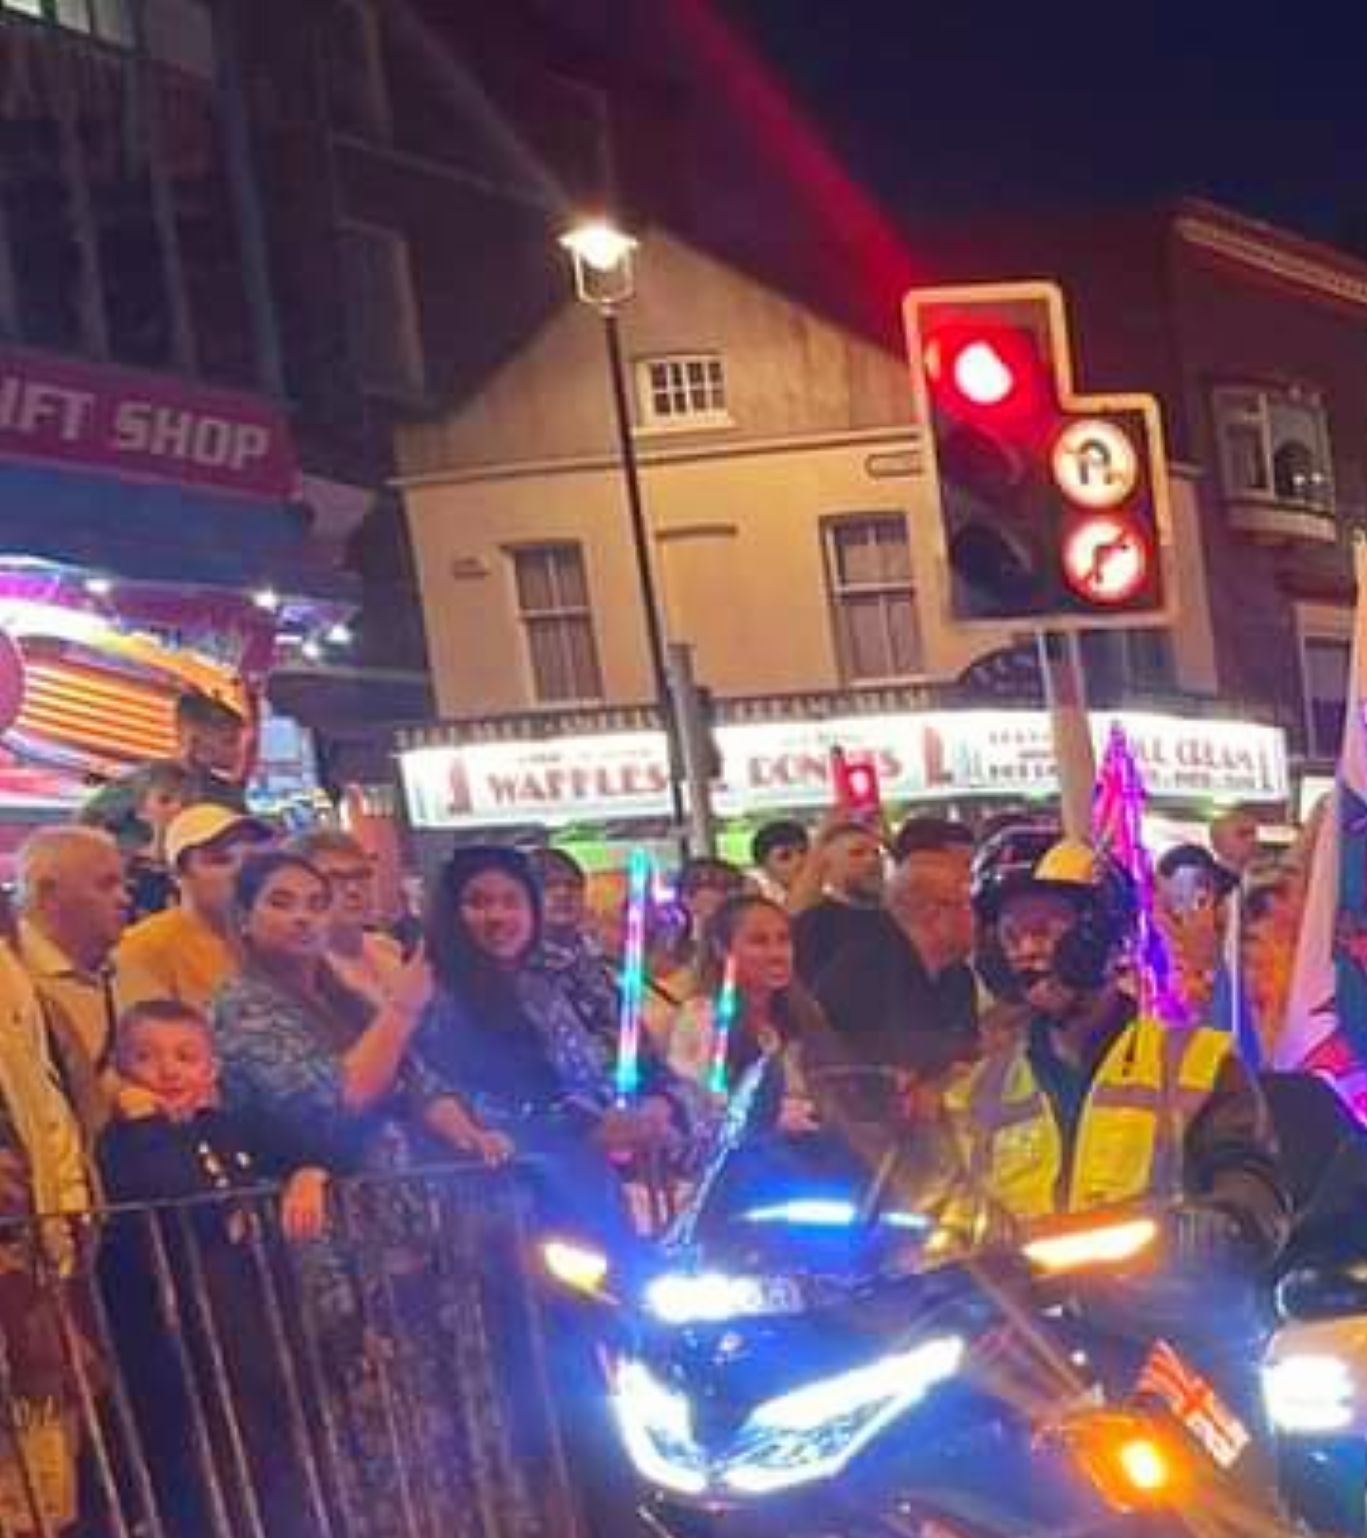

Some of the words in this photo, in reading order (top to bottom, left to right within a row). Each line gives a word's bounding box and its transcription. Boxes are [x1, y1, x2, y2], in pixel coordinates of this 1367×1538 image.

[0, 376, 96, 441] IFT
[114, 400, 269, 470] SHOP
[486, 761, 668, 805] WAFFLES
[748, 748, 902, 786] DONS
